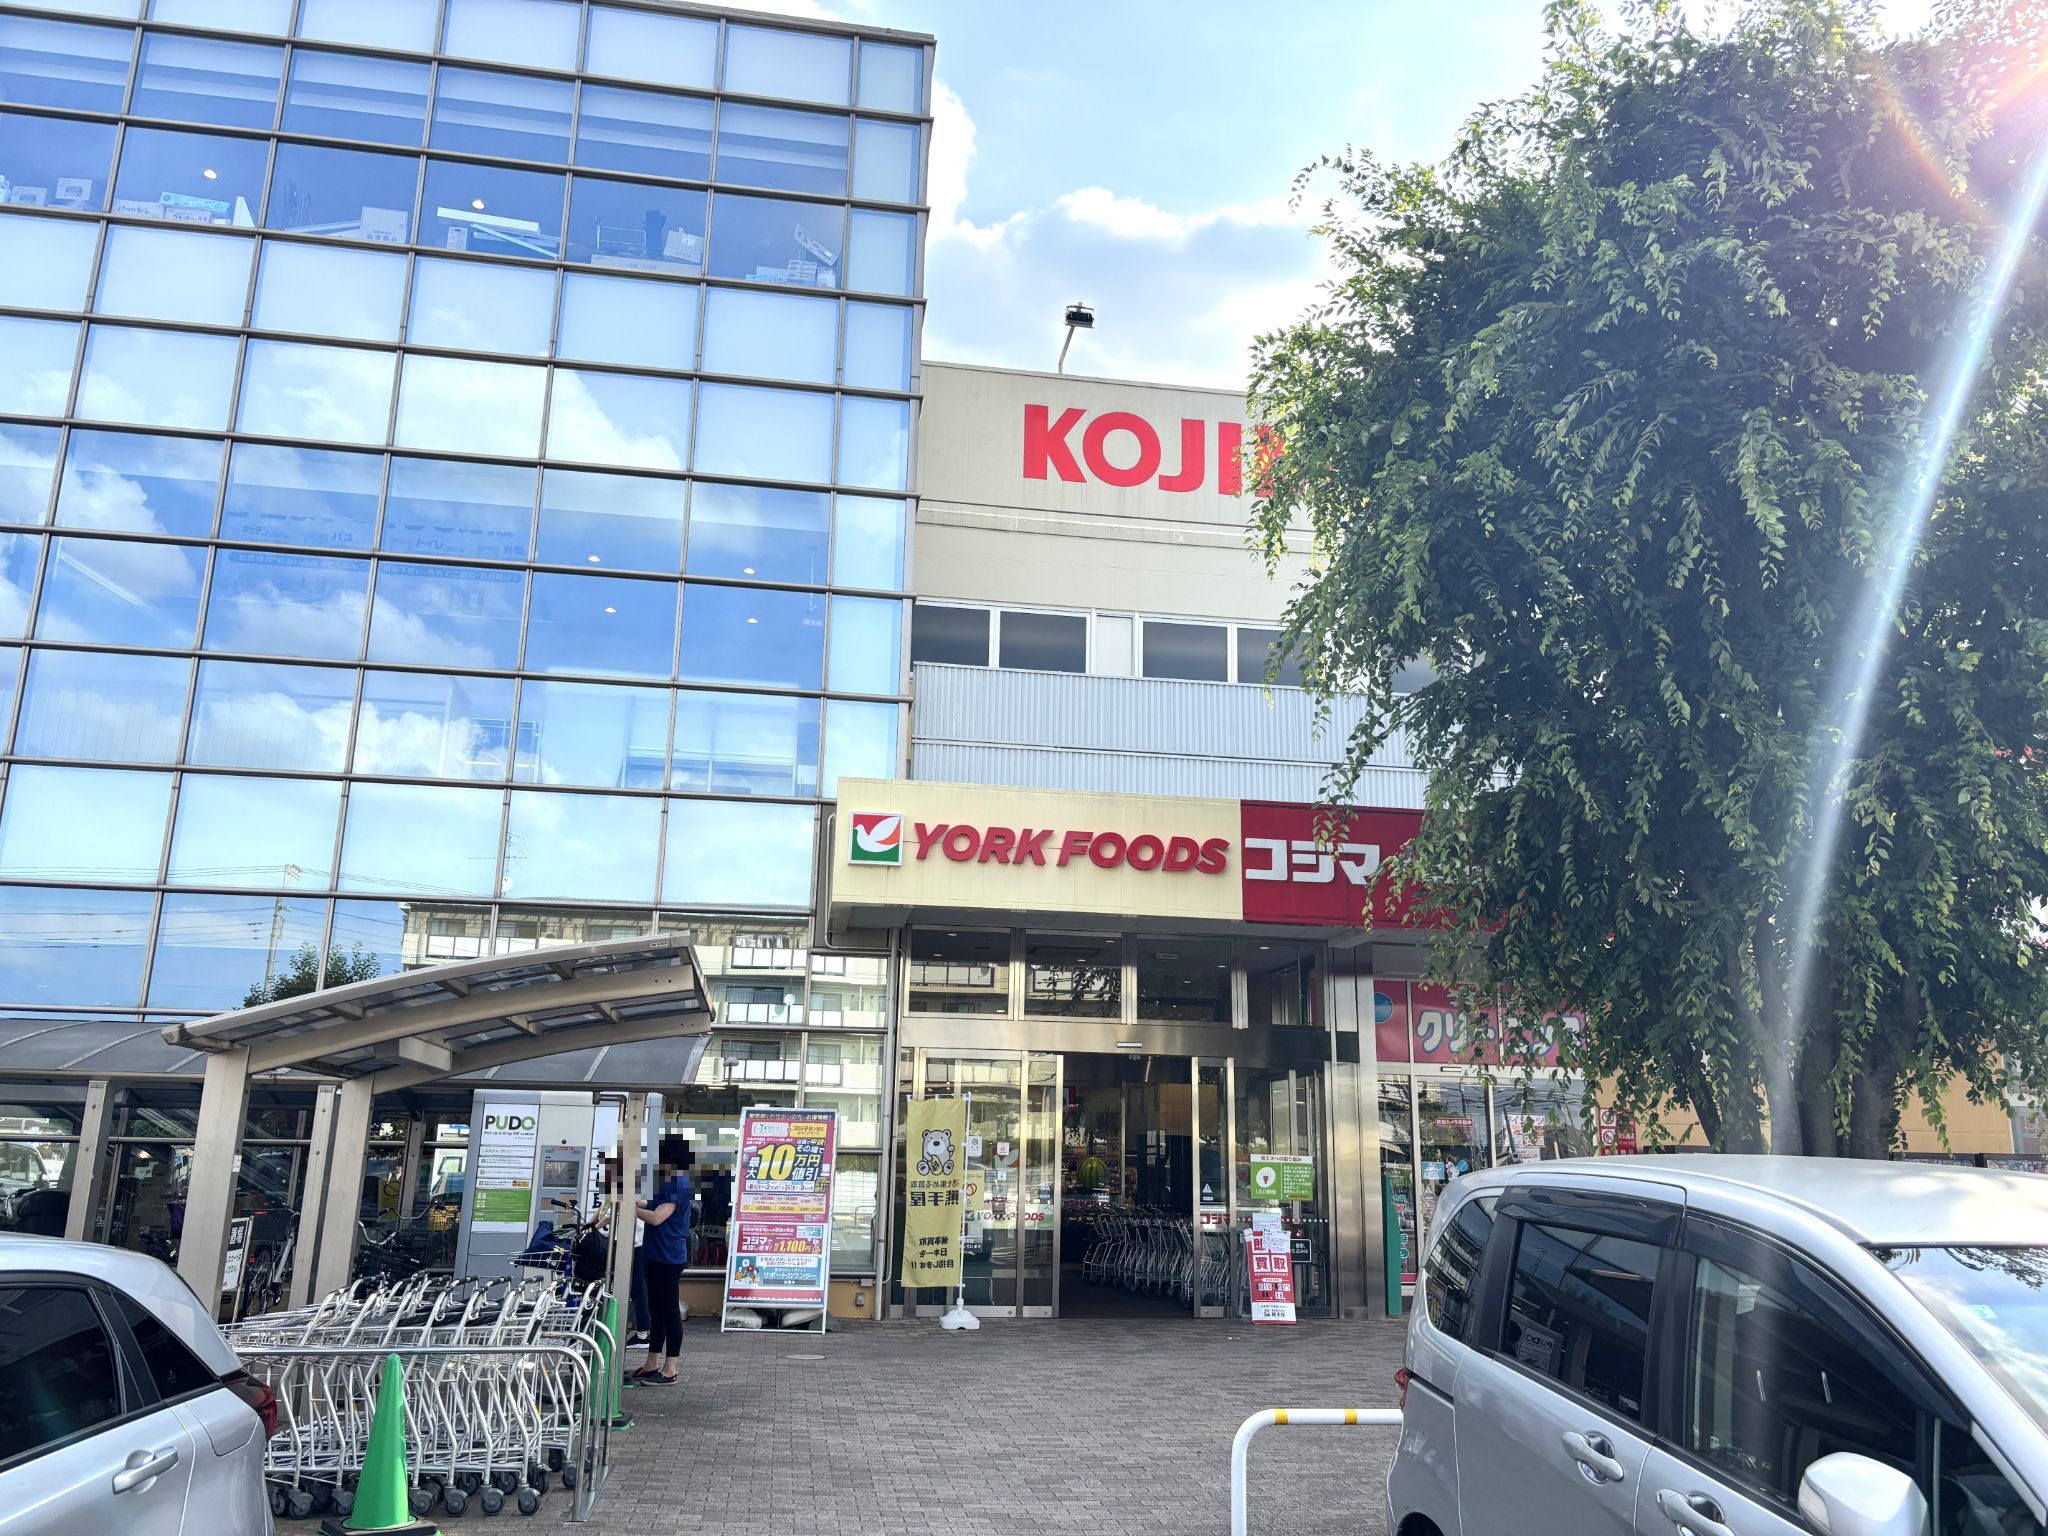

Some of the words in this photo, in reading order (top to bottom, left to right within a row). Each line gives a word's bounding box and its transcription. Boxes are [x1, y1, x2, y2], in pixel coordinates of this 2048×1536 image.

[914, 822, 1053, 866] YORK
[1056, 831, 1230, 875] FOODS
[1245, 838, 1380, 886] コジマ
[485, 1114, 536, 1131] PUDO
[746, 1156, 760, 1179] 最大
[756, 1144, 796, 1180] 10
[794, 1154, 821, 1167] 万円
[791, 1167, 819, 1181] 値引
[1255, 1256, 1286, 1270] 買取
